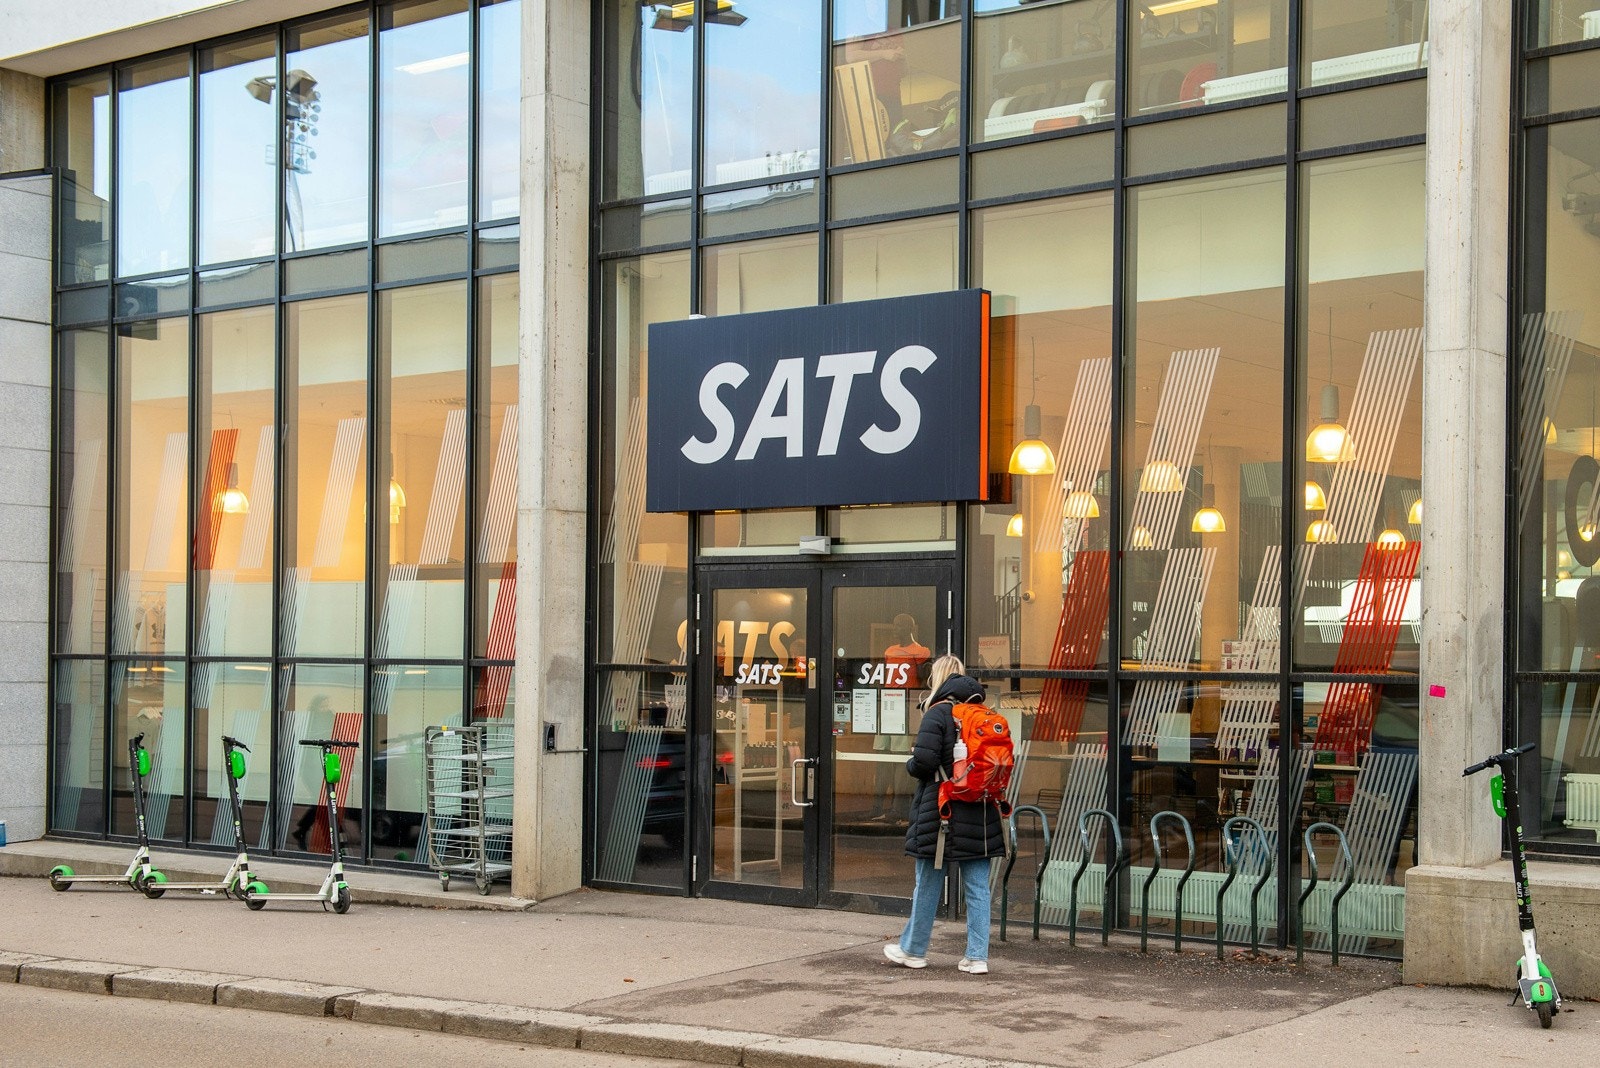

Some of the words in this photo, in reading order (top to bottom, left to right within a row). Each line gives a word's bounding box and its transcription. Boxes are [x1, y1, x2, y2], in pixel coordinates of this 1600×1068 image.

[680, 344, 938, 464] SATS
[735, 663, 784, 685] SATS
[857, 662, 911, 685] SATS
